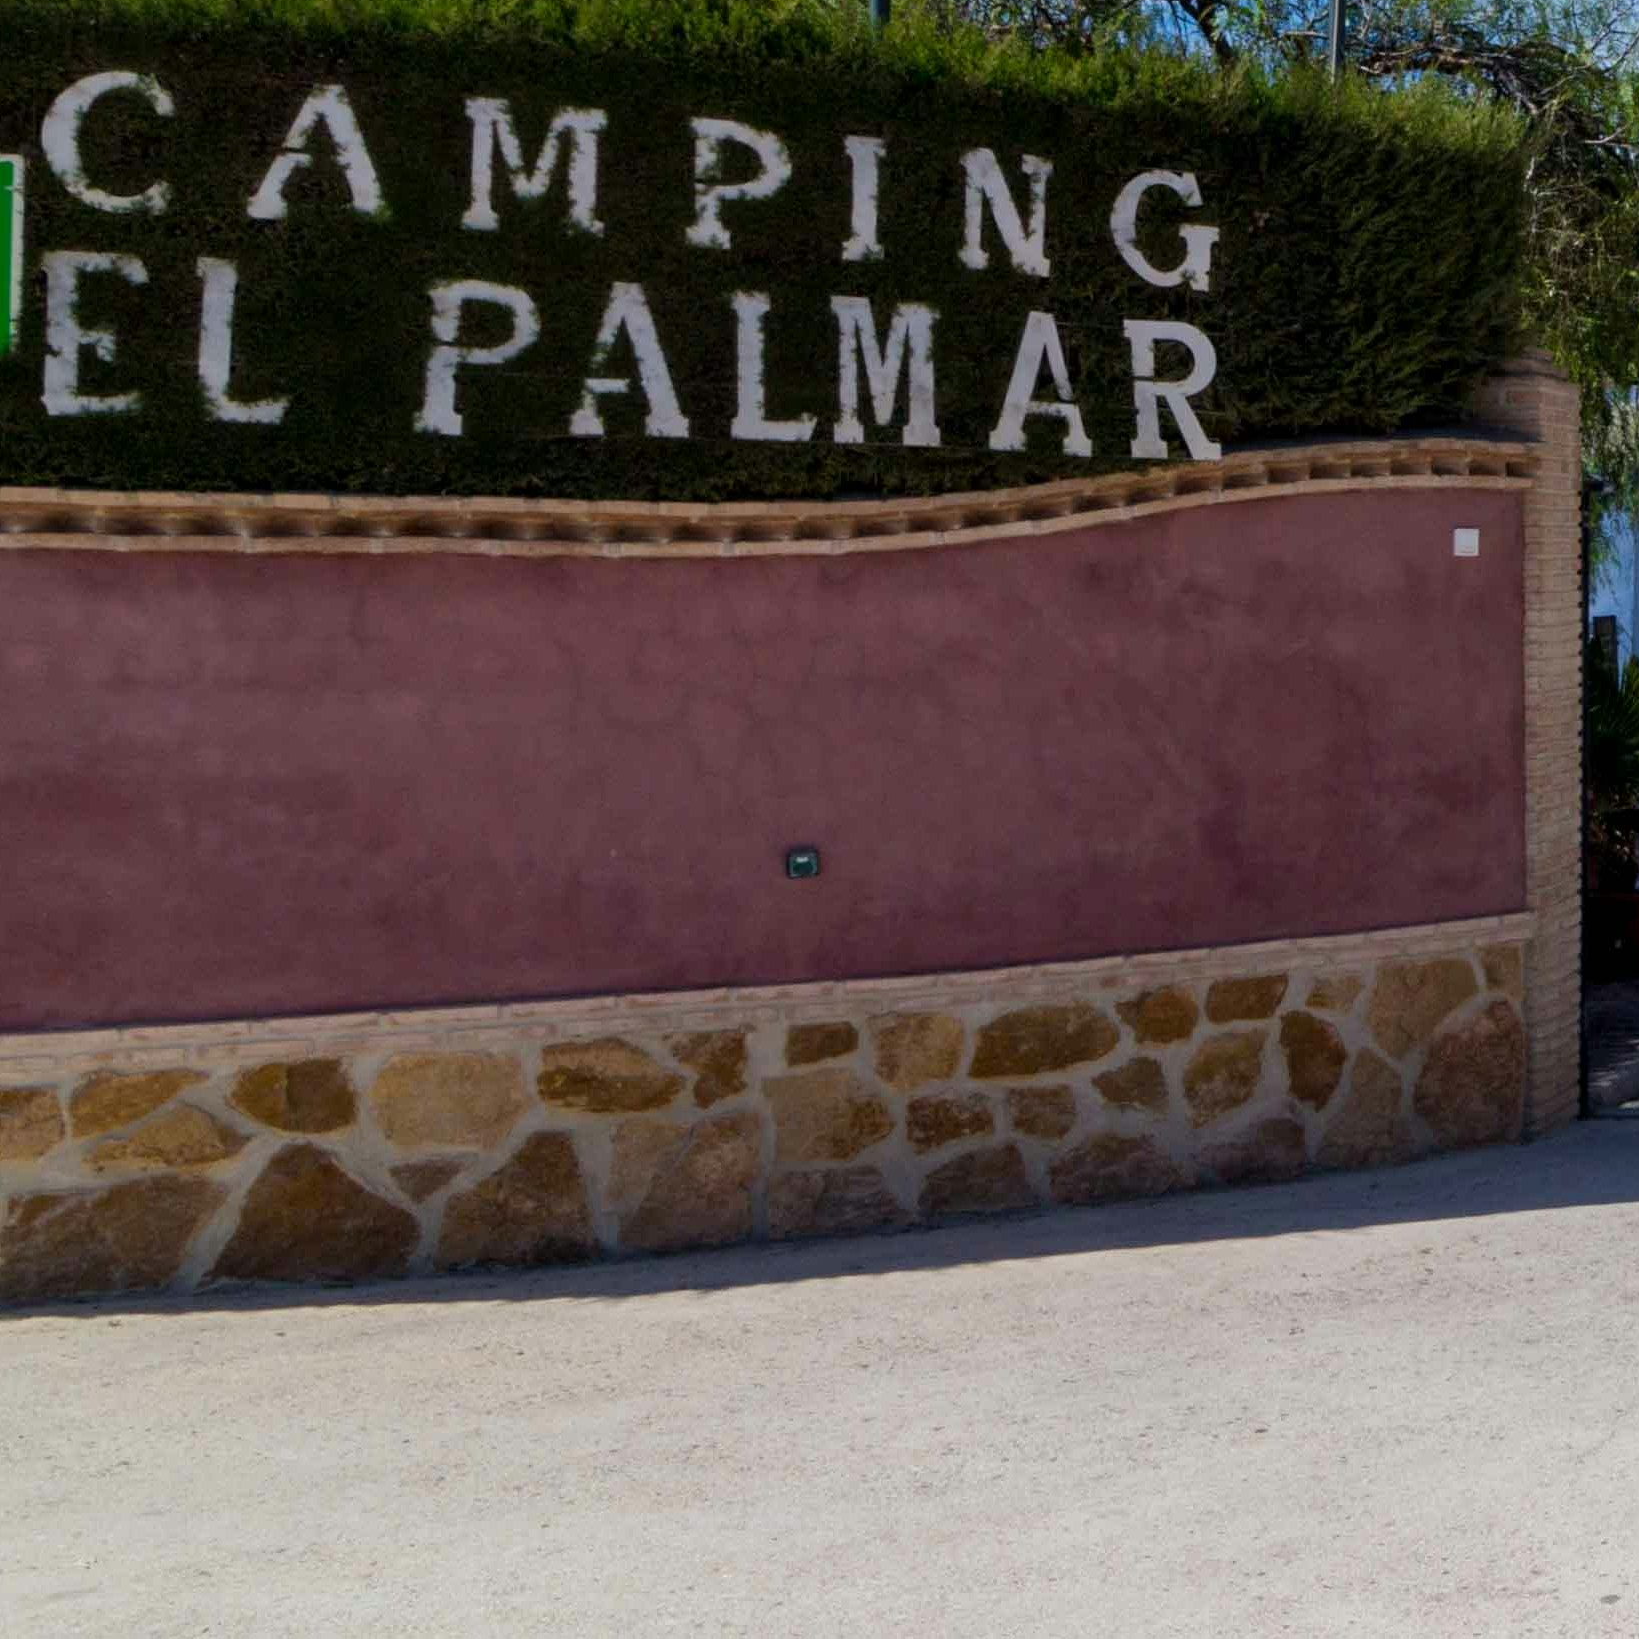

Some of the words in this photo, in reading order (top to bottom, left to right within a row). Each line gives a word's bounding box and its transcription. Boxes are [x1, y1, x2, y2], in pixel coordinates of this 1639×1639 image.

[40, 71, 1222, 293] CAMPING
[40, 250, 290, 424] EL
[412, 279, 1223, 462] PALMAR
